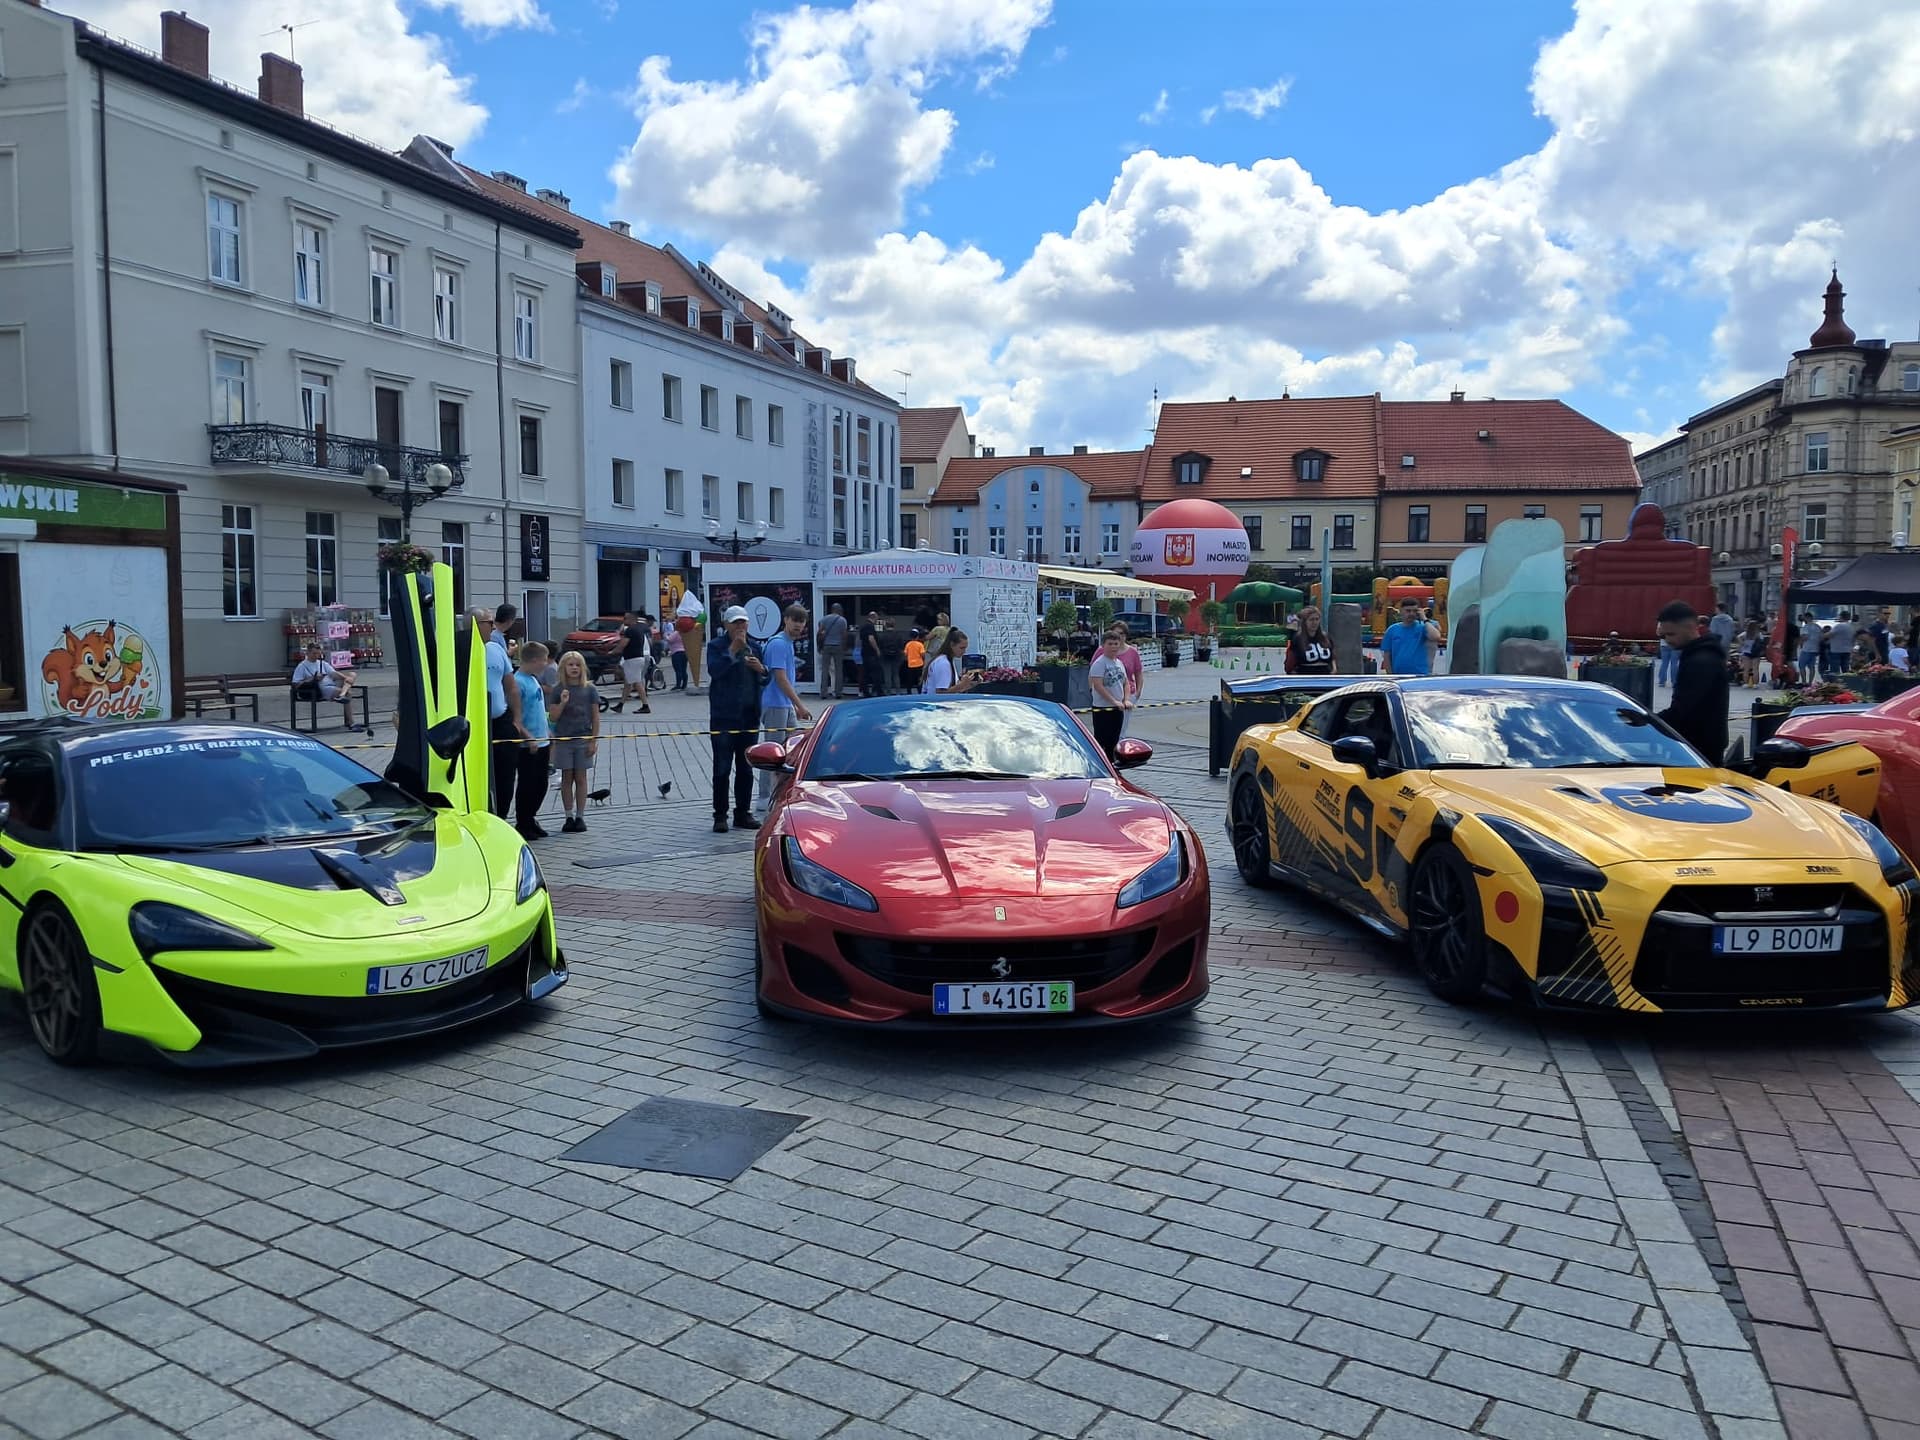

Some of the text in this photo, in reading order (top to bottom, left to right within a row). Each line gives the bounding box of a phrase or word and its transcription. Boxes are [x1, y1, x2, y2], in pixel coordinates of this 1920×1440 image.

[1222, 541, 1247, 551] MIASTO
[834, 564, 913, 576] MANUFAKTURA
[178, 743, 206, 753] SIĘ
[207, 739, 261, 749] RAZEM
[265, 739, 275, 747] Z
[1730, 929, 1760, 951] L9
[1772, 928, 1834, 950] BOOM
[383, 966, 413, 989] L6
[423, 949, 486, 985] CZUCZ
[1050, 990, 1068, 1005] 26
